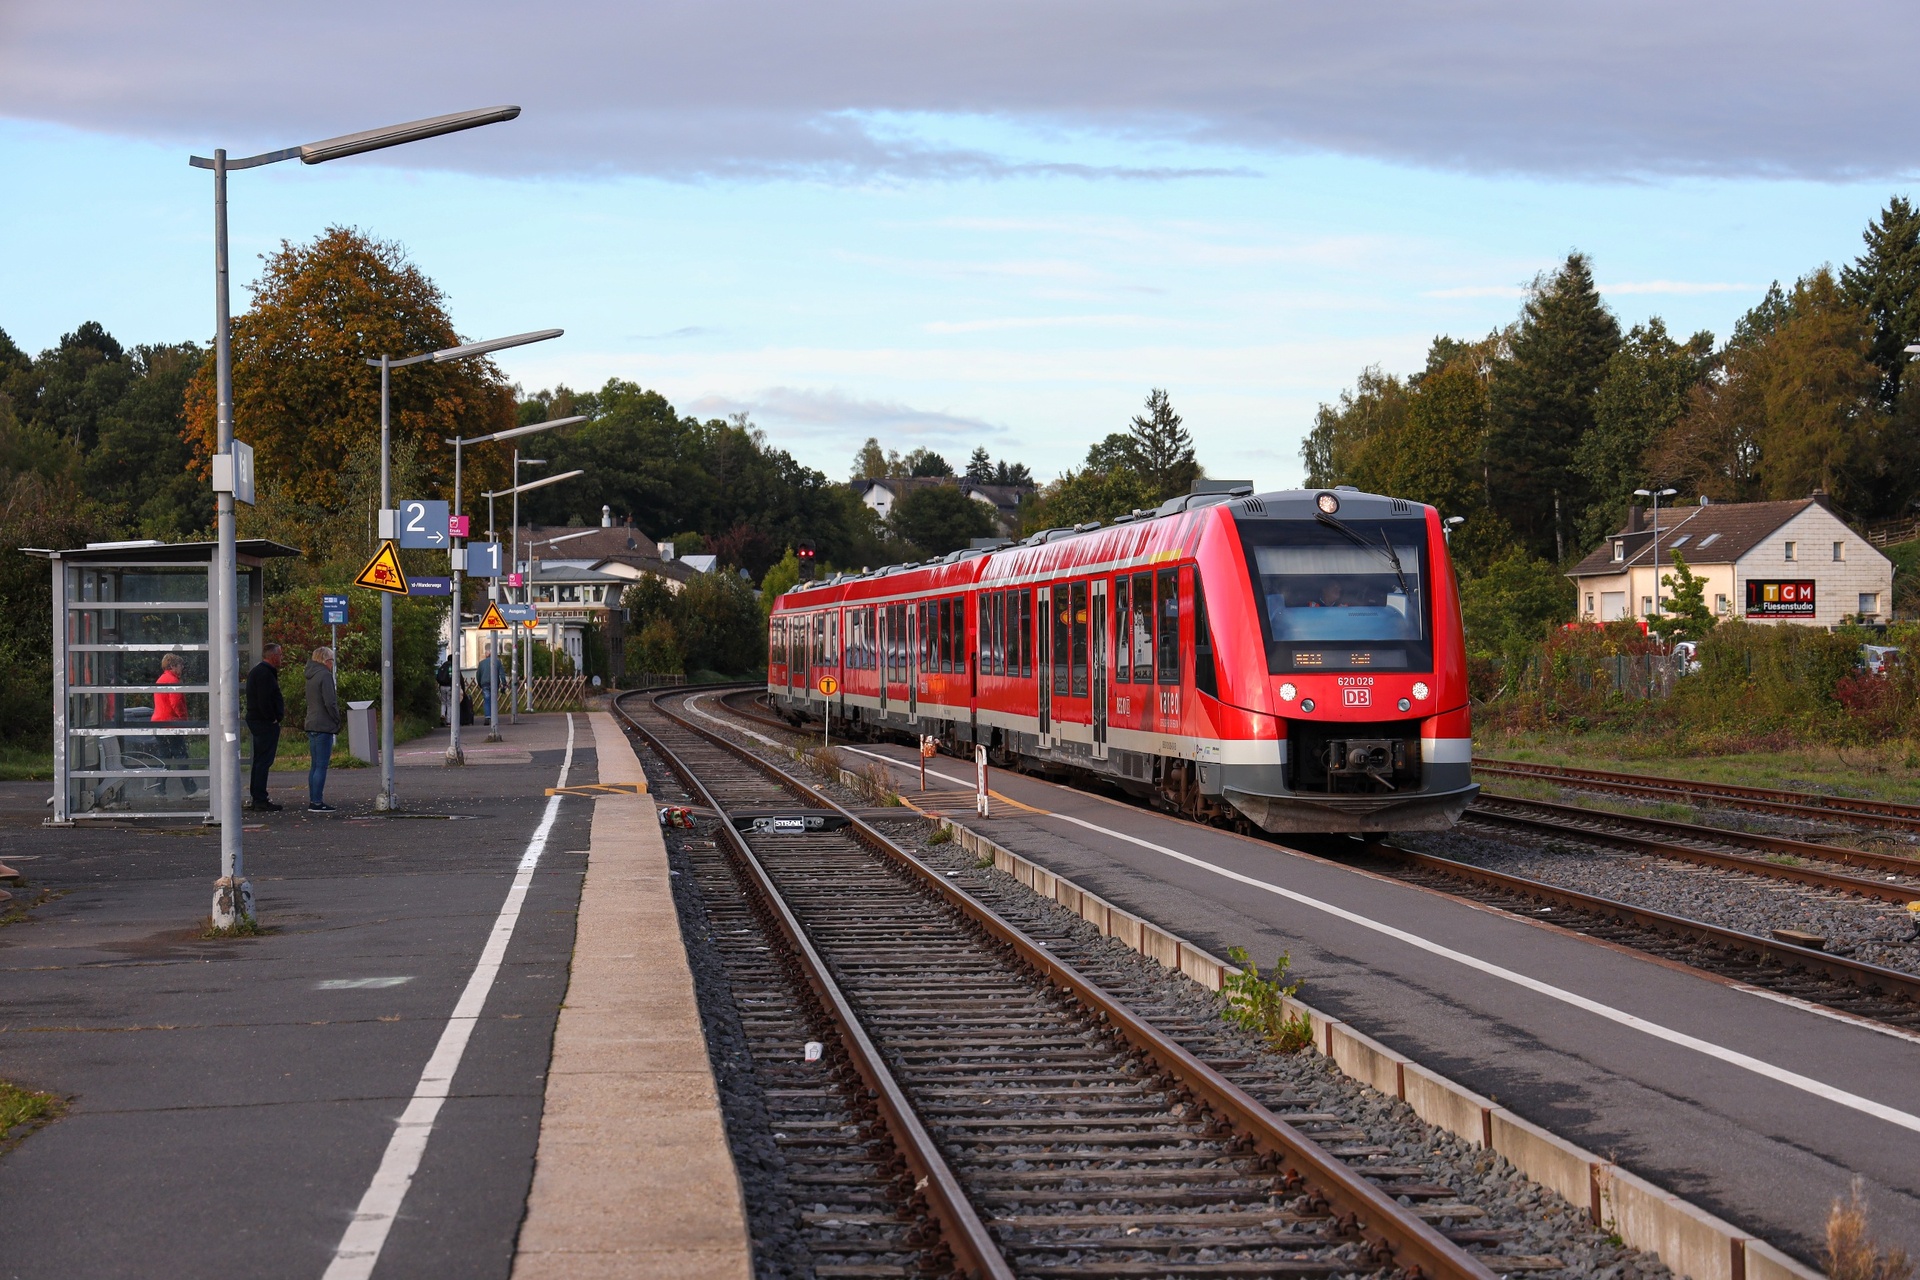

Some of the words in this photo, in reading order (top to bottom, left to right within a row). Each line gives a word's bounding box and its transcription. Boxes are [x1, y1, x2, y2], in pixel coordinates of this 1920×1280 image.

[406, 503, 425, 532] 2
[486, 544, 498, 569] 1
[1766, 586, 1811, 600] TGM
[1763, 602, 1814, 610] Fliesenstudio
[1337, 677, 1355, 686] 620
[1356, 677, 1374, 686] 028
[1346, 690, 1368, 704] DB
